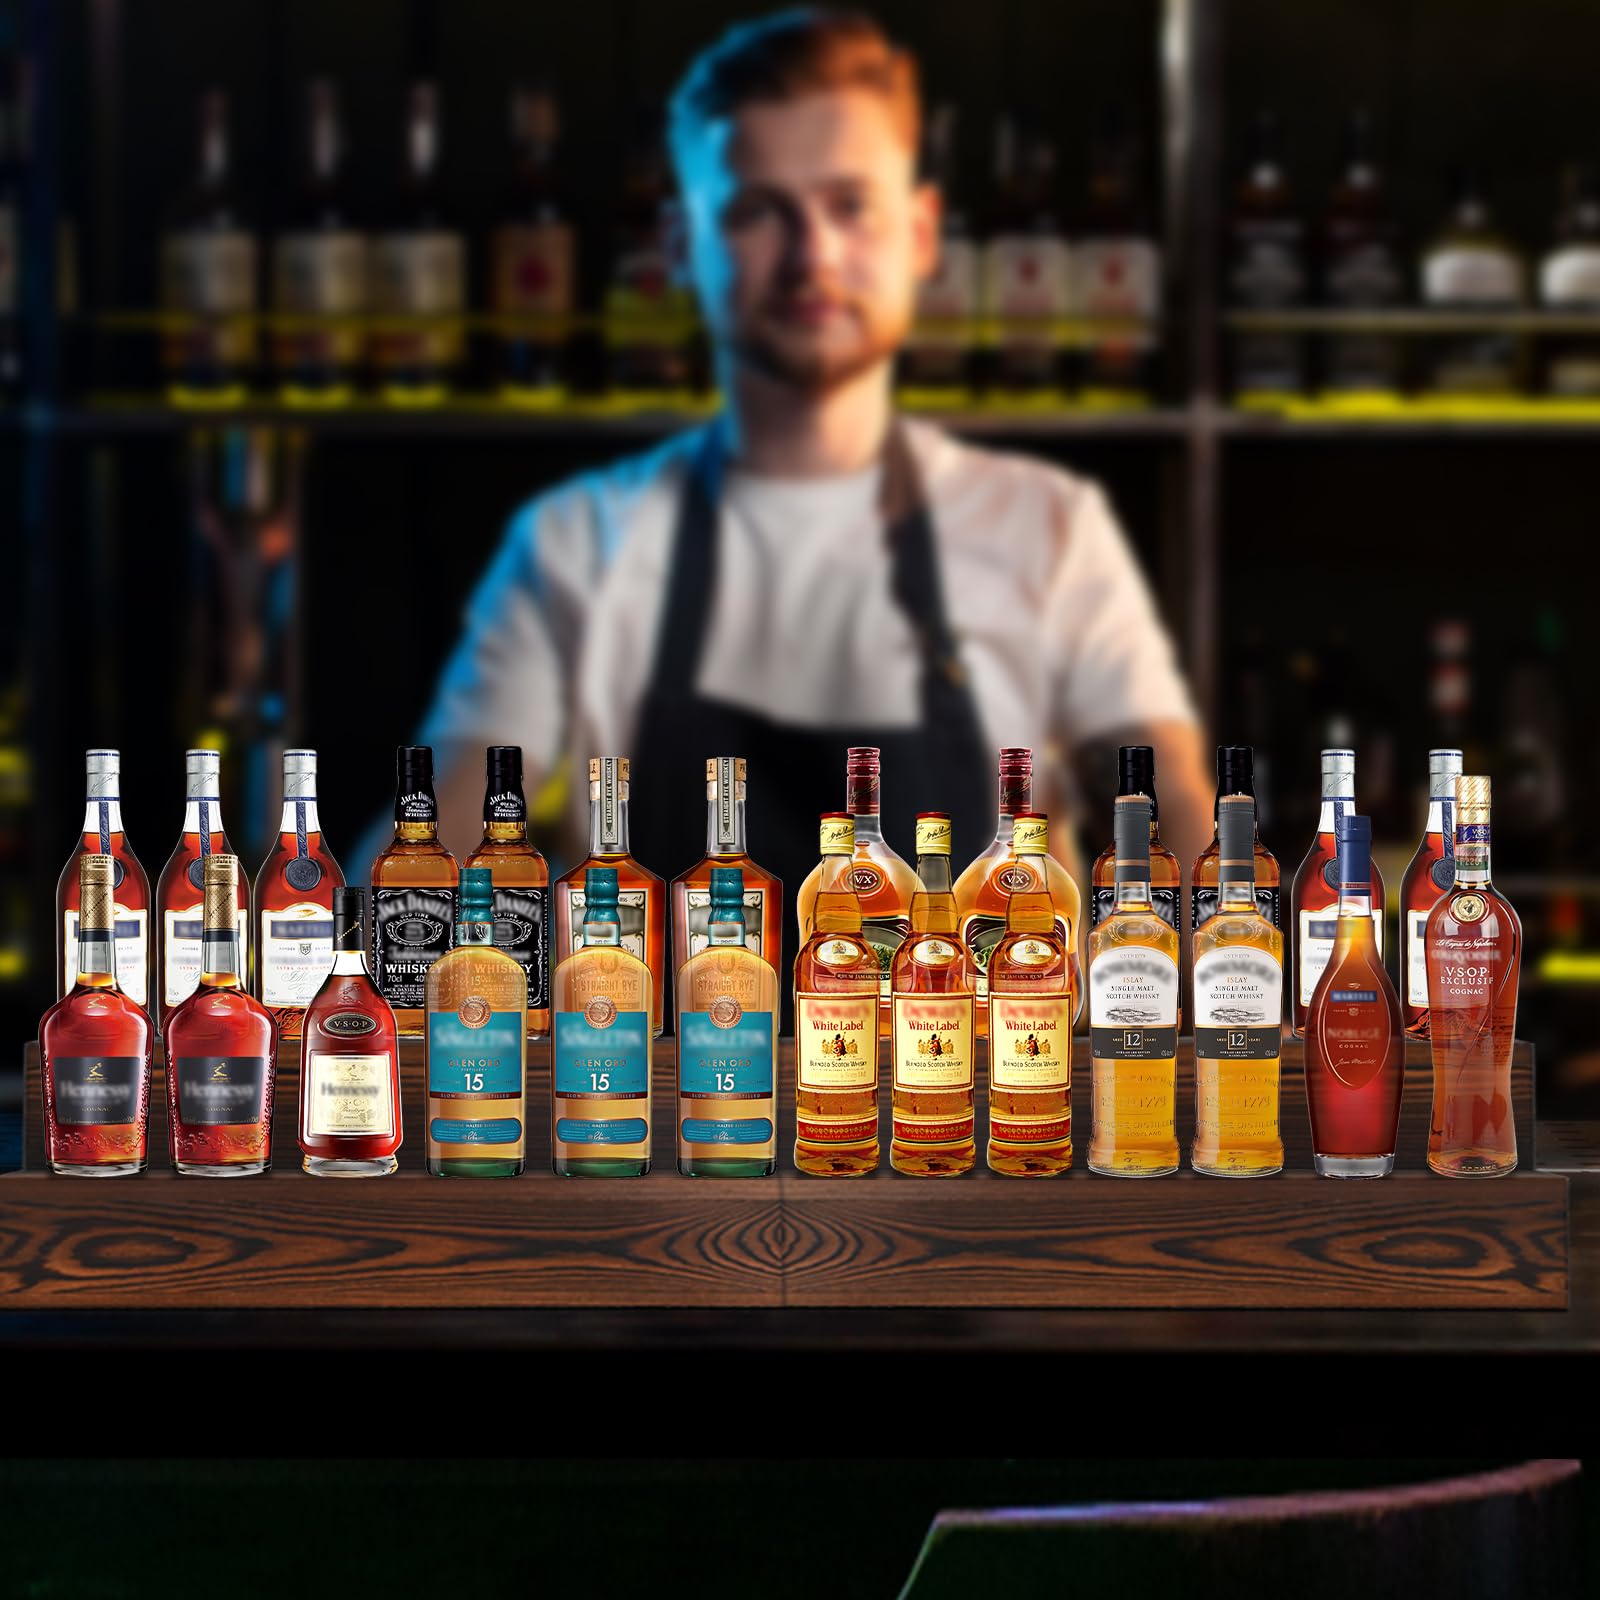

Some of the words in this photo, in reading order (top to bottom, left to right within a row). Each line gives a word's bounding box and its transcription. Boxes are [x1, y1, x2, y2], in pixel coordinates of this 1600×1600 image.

[1440, 977, 1494, 985] EXCLUSIF
[812, 1020, 839, 1031] White
[840, 1020, 864, 1031] Label
[908, 1020, 935, 1031] White
[936, 1020, 960, 1031] Label
[1005, 1020, 1031, 1031] White
[1033, 1020, 1057, 1031] Label
[1126, 1033, 1141, 1046] 12
[1230, 1033, 1245, 1046] 12
[447, 1059, 475, 1067] GLEN
[574, 1059, 601, 1067] GLEN
[699, 1059, 726, 1067] GLEN
[464, 1073, 484, 1091] 15
[590, 1073, 610, 1091] 15
[715, 1073, 735, 1091] 15
